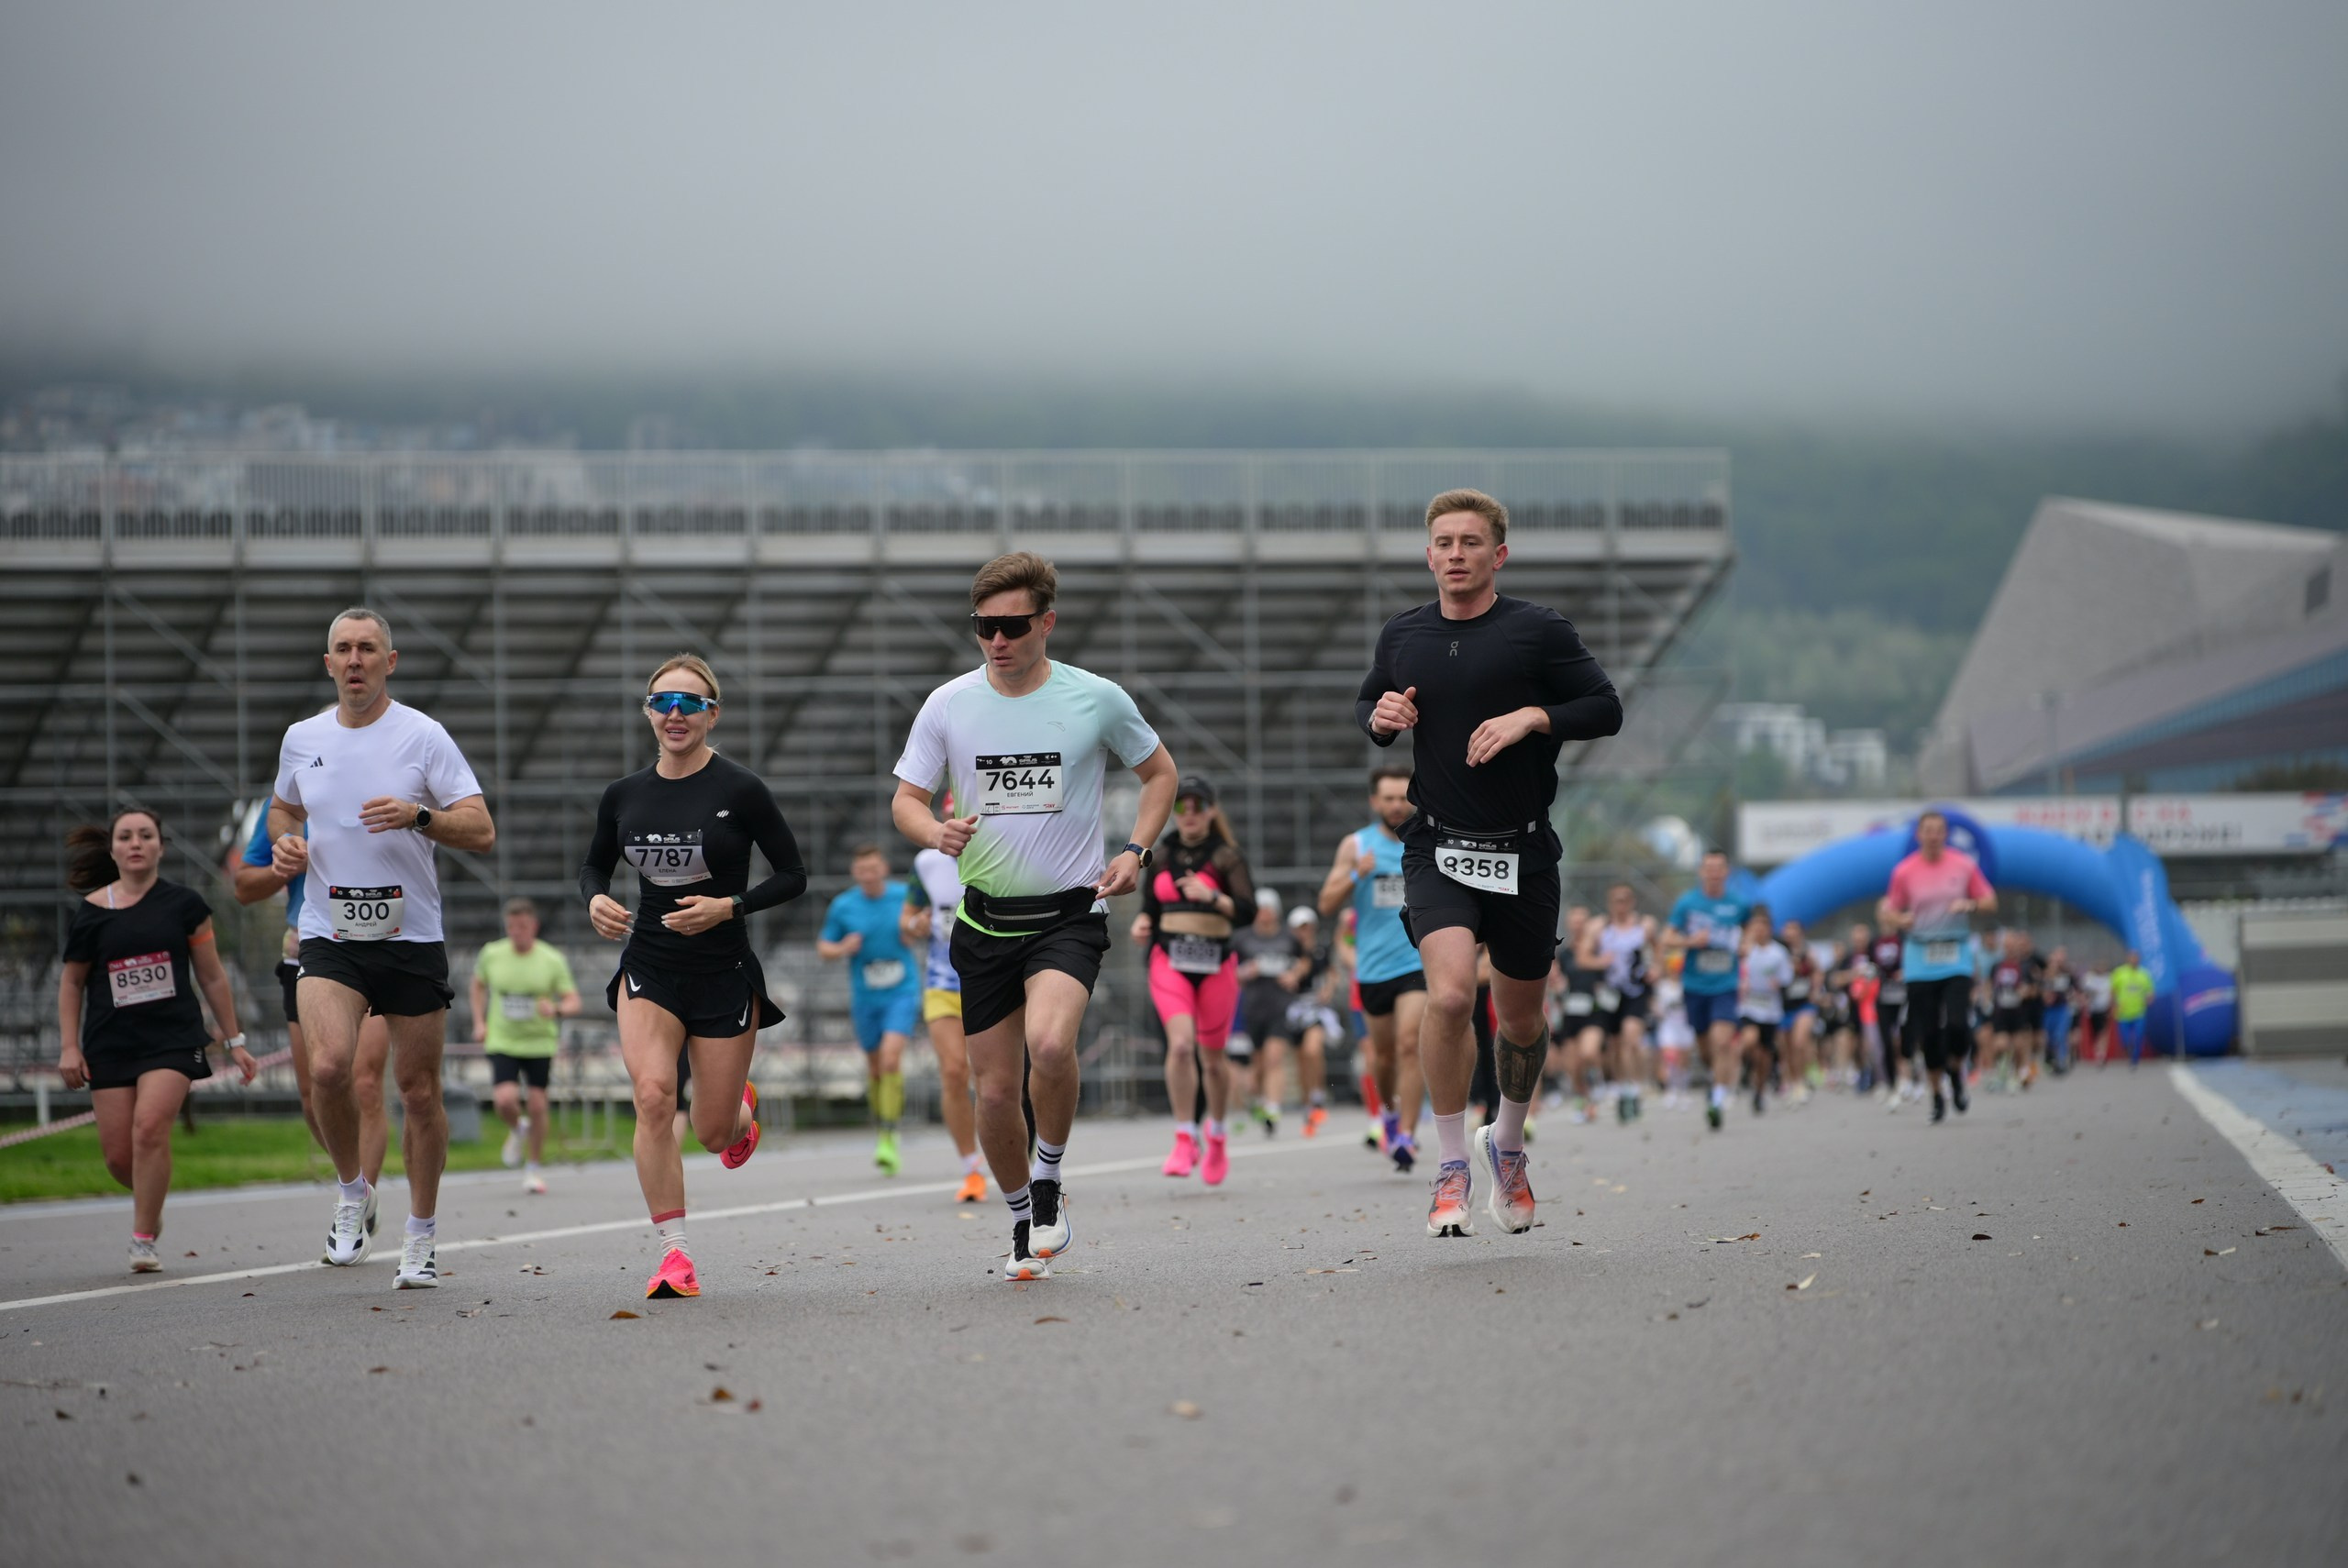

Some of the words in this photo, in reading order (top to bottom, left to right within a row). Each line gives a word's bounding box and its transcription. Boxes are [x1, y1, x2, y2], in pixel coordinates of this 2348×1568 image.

[985, 768, 1056, 791] 7644
[635, 848, 693, 867] 7787
[1443, 856, 1510, 880] 8358
[343, 901, 390, 921] 300
[116, 966, 167, 988] 8530
